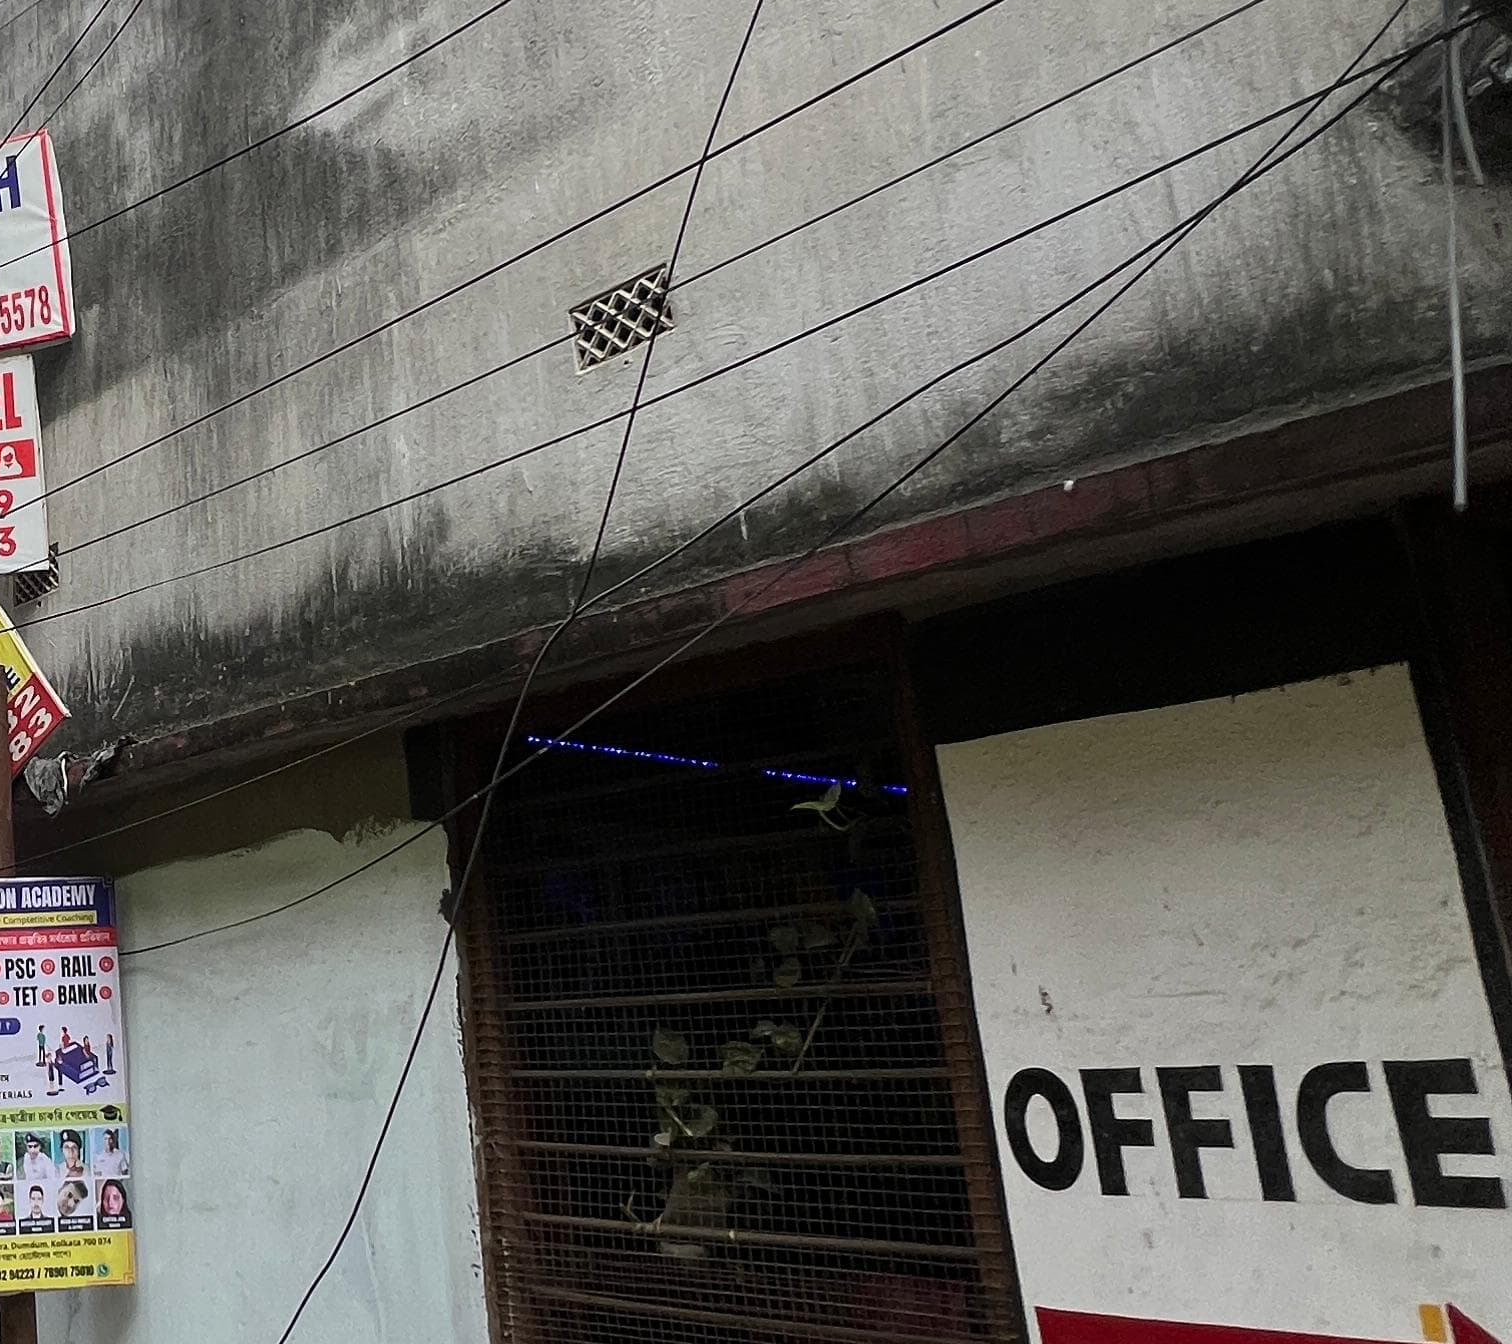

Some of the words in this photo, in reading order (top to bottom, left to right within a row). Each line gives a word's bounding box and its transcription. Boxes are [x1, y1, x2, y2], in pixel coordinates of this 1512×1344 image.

[22, 884, 96, 907] ACADEMY
[56, 912, 94, 924] Coaching
[5, 958, 36, 979] PSC
[60, 956, 96, 978] RAIL
[13, 986, 38, 1007] TET
[58, 984, 98, 1005] BANK
[1003, 1058, 1509, 1210] OFFICE
